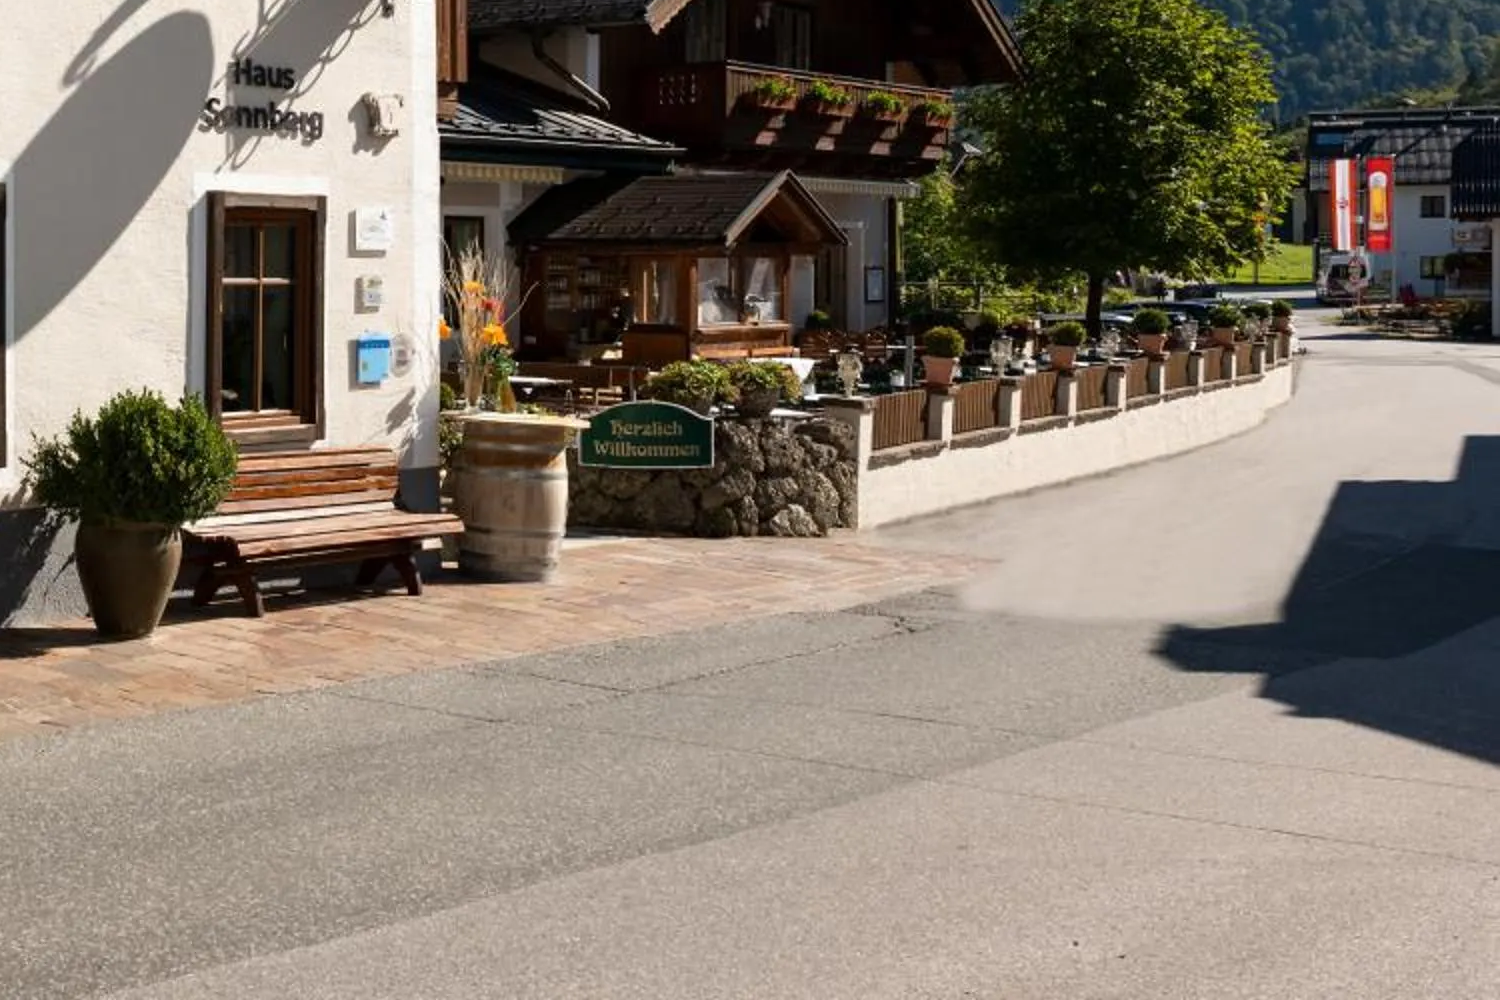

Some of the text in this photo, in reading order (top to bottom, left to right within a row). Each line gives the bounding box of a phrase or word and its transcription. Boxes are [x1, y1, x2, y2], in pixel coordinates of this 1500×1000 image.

[233, 57, 296, 90] Haus
[204, 97, 324, 141] Sonnberg
[593, 440, 701, 457] Willkommen
